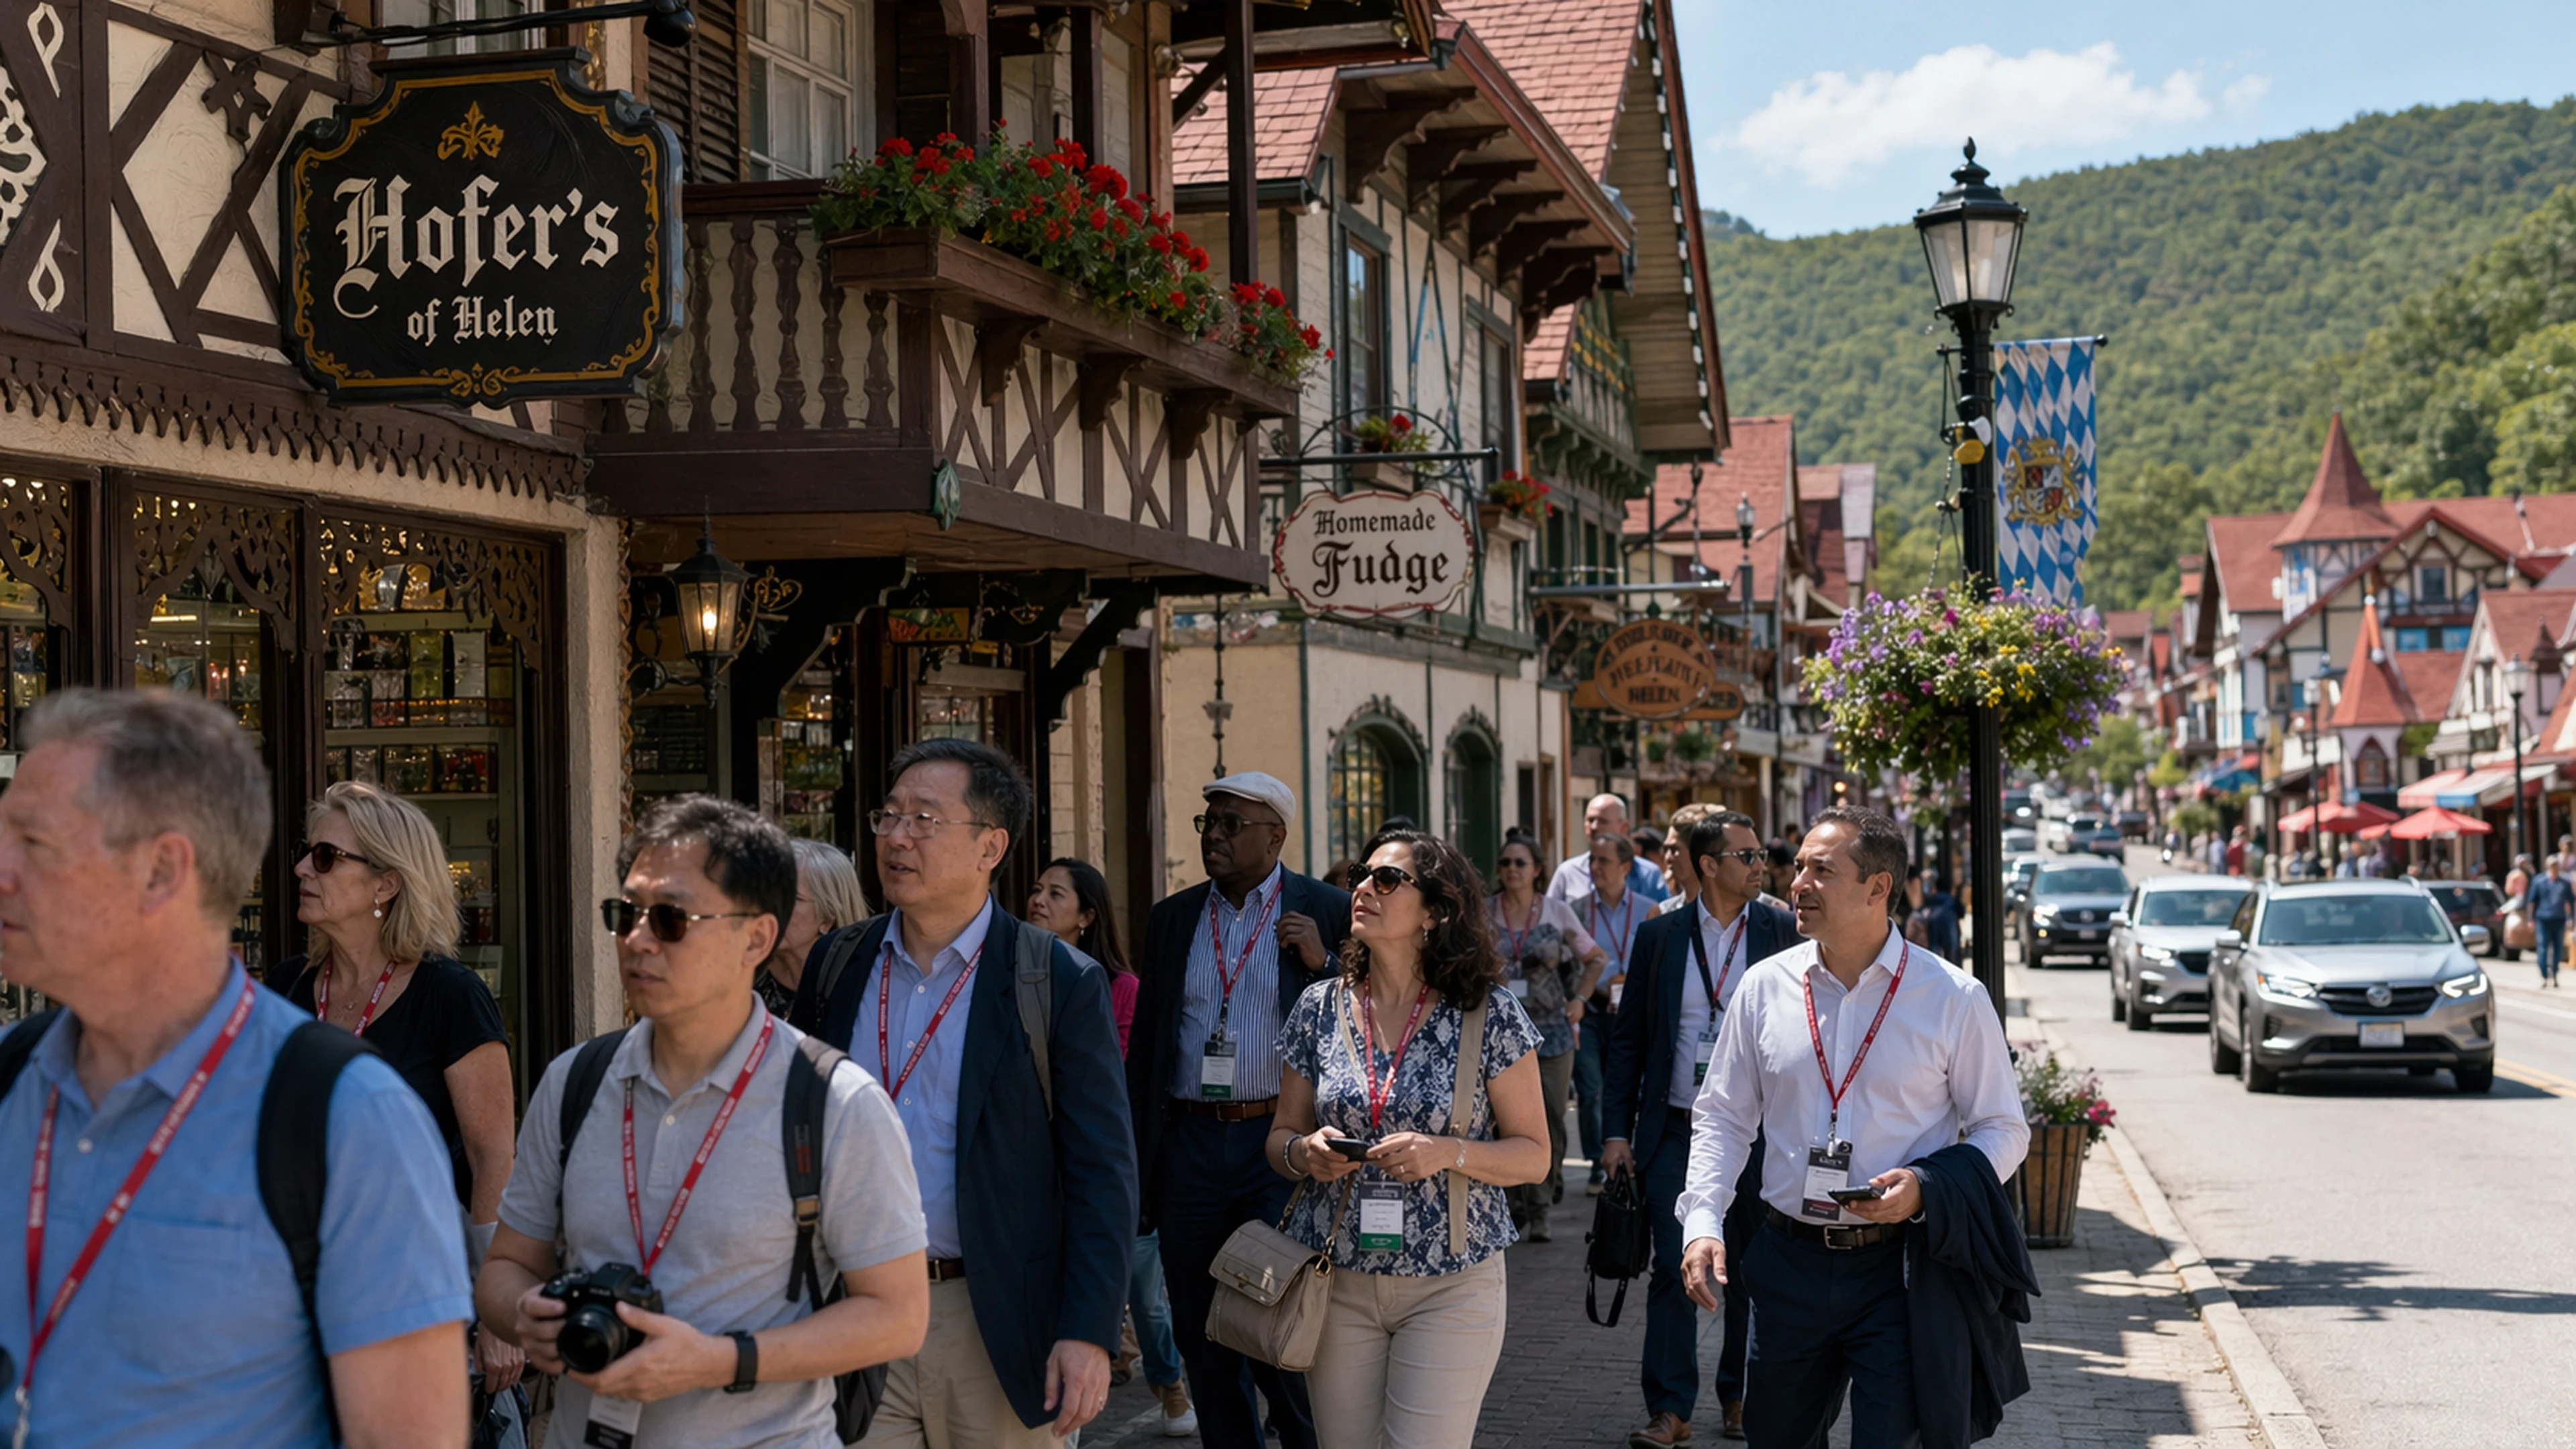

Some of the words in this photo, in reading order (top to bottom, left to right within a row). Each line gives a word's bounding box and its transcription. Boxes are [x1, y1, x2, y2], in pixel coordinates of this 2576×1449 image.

[333, 174, 619, 318] Hofer's
[407, 298, 441, 347] of
[452, 295, 558, 345] Helen
[1312, 507, 1436, 537] Homemade
[1312, 539, 1449, 597] Fudge
